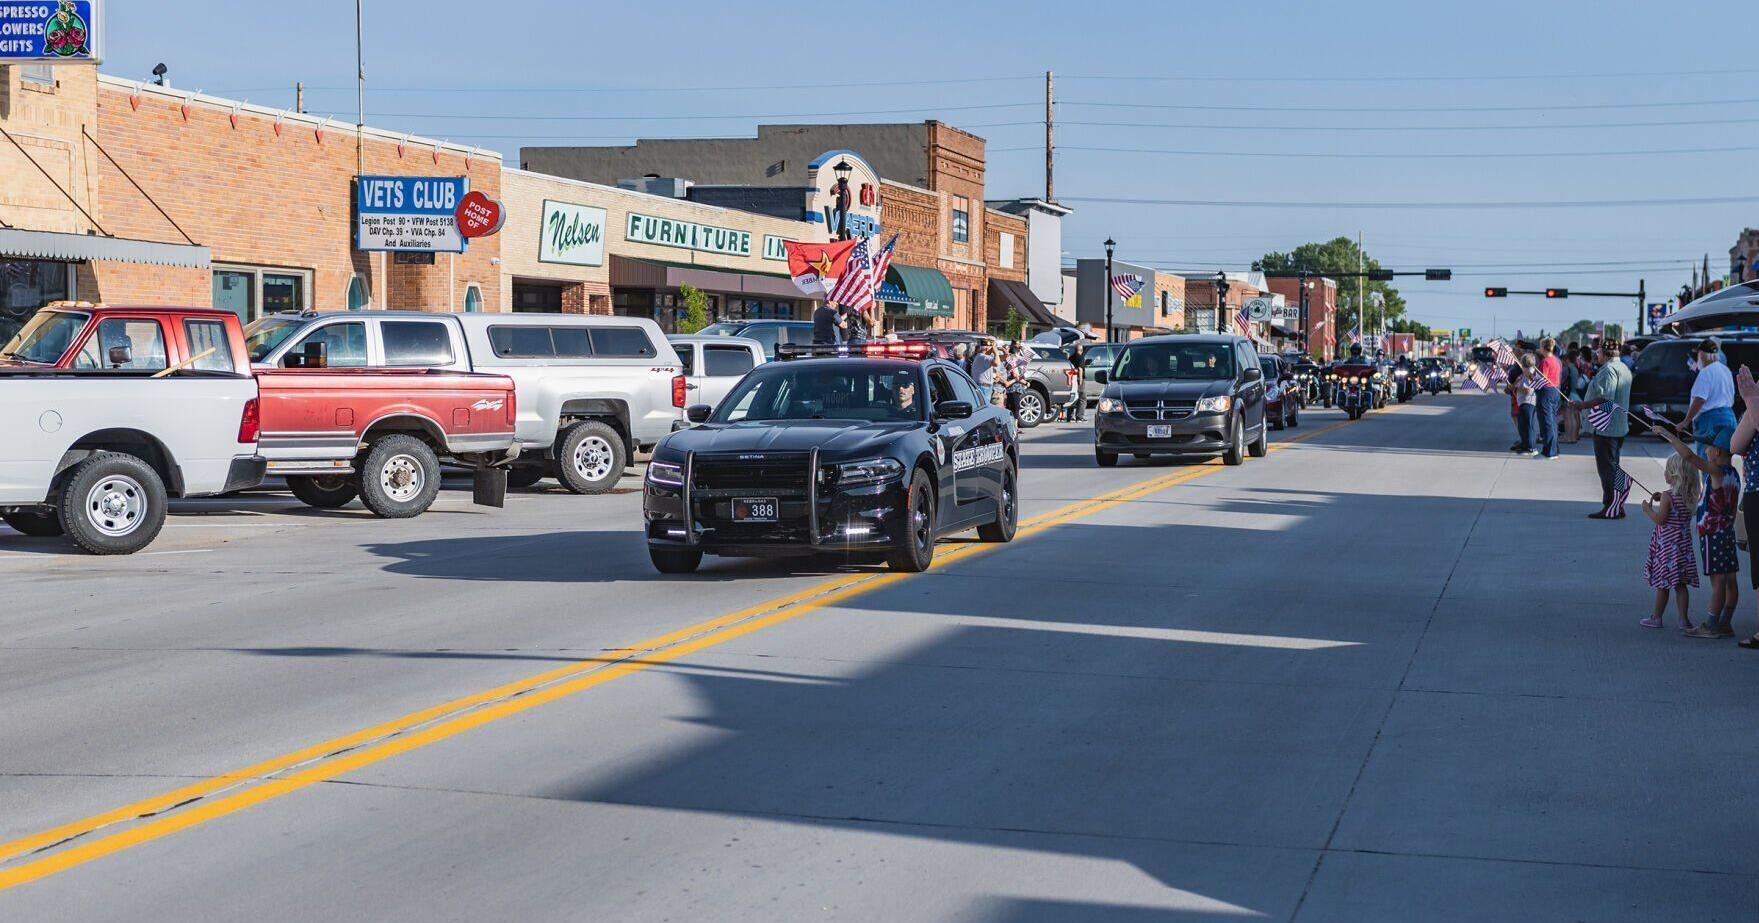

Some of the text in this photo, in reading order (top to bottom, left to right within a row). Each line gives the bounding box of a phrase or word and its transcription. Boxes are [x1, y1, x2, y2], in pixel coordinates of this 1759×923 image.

[0, 6, 48, 18] PRESSO
[0, 23, 44, 35] OWERS
[0, 40, 34, 52] GIFTS
[363, 180, 455, 209] VETS CLUB
[468, 201, 492, 216] POST
[361, 216, 454, 226] Legion Post 90 VFW Post 5138
[464, 209, 490, 226] HOME
[467, 220, 480, 229] OF
[369, 228, 445, 238] DAV Chp. 39 VVA Chp. 84
[550, 210, 600, 252] Nelsen
[630, 215, 750, 253] FURNITURE
[384, 240, 431, 248] And Auxiliaries
[1283, 308, 1298, 318] BAR
[953, 442, 1004, 473] STATE TROOPER
[752, 504, 773, 516] 388
